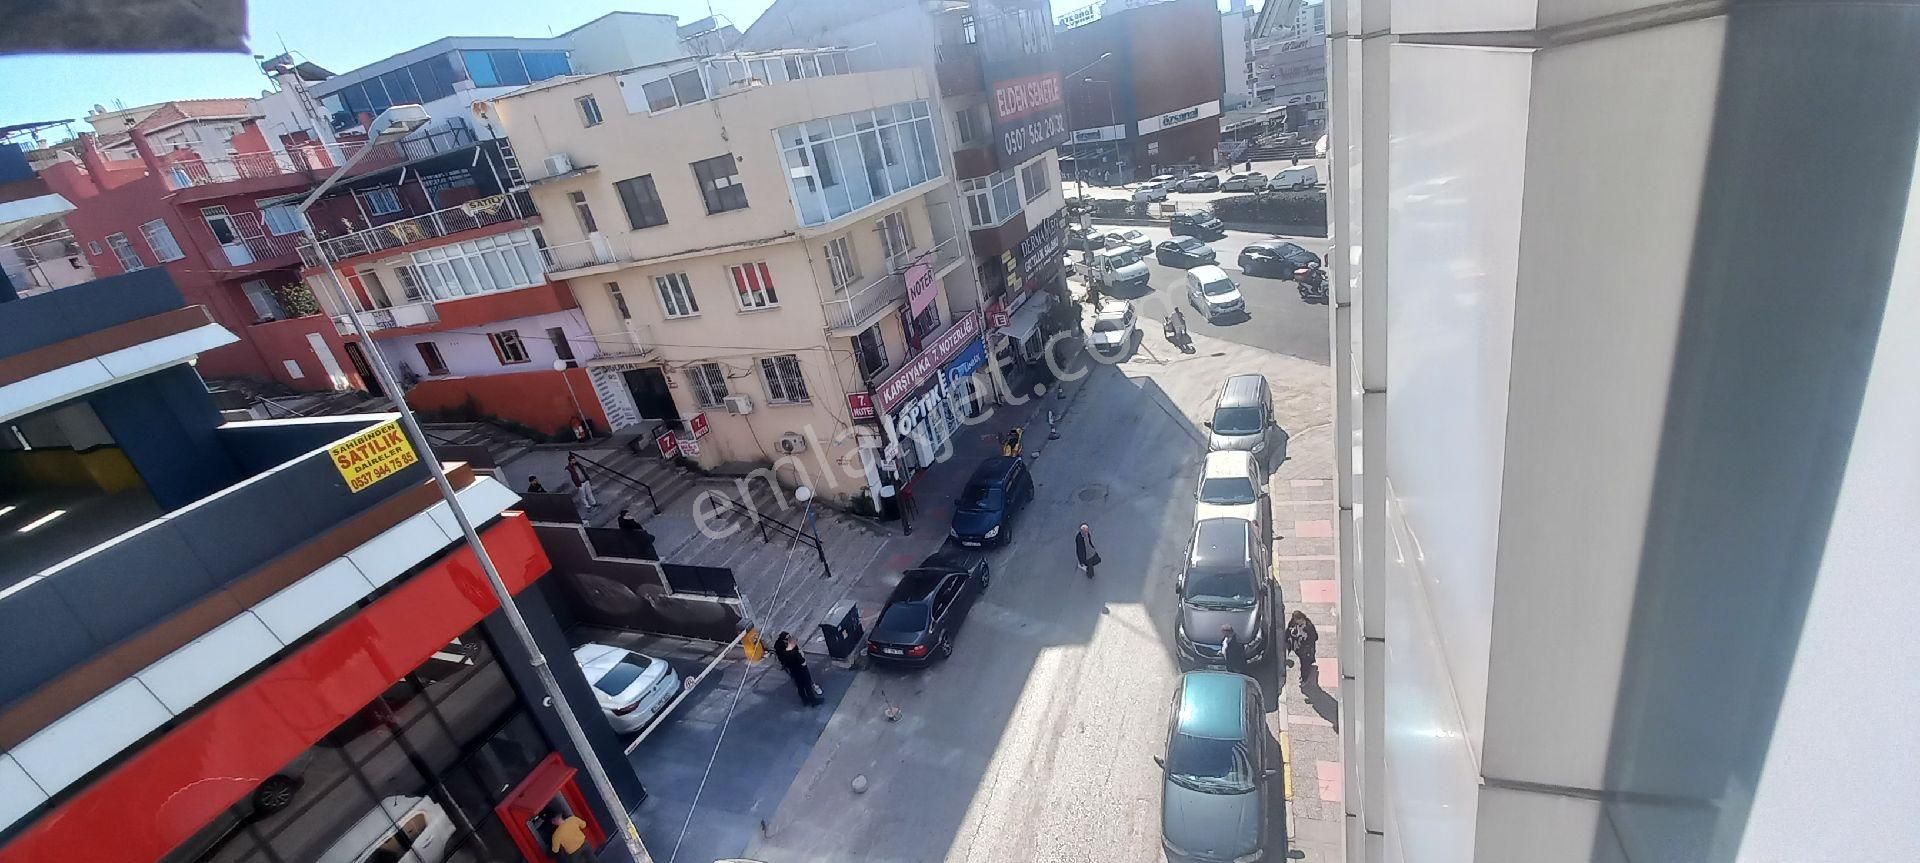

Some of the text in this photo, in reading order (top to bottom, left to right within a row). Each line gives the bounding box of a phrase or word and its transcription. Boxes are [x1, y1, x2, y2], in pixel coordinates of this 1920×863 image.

[996, 83, 1029, 118] ELDEN
[1004, 127, 1026, 156] 0507
[1028, 121, 1043, 145] 562
[1044, 117, 1055, 139] 20
[910, 269, 934, 301] NOTER
[882, 355, 931, 404] KARŞIYAKA
[931, 349, 939, 361] 7.
[857, 395, 866, 406] 7.
[337, 430, 404, 470] SATILIK
[350, 452, 414, 490] 0537 944 75 85
